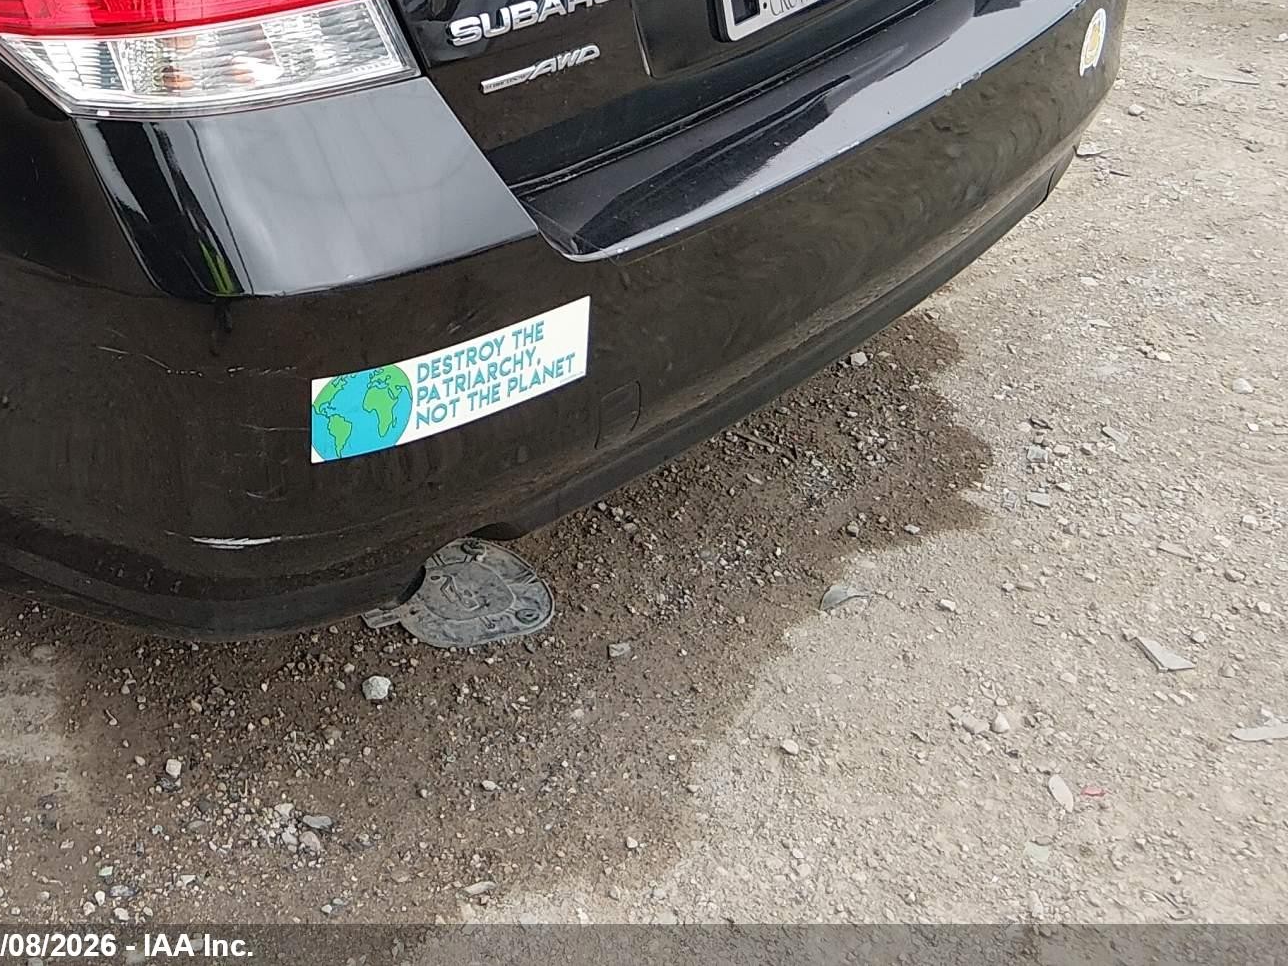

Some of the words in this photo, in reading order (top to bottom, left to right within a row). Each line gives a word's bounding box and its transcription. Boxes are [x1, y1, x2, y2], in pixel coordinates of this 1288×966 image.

[527, 43, 601, 81] AWD
[416, 335, 505, 384] DESTROY
[511, 320, 545, 349] THE
[416, 346, 542, 407] PATRIARCHY,
[415, 398, 460, 430] NOT
[467, 385, 501, 412] THE
[507, 352, 576, 398] PLANET
